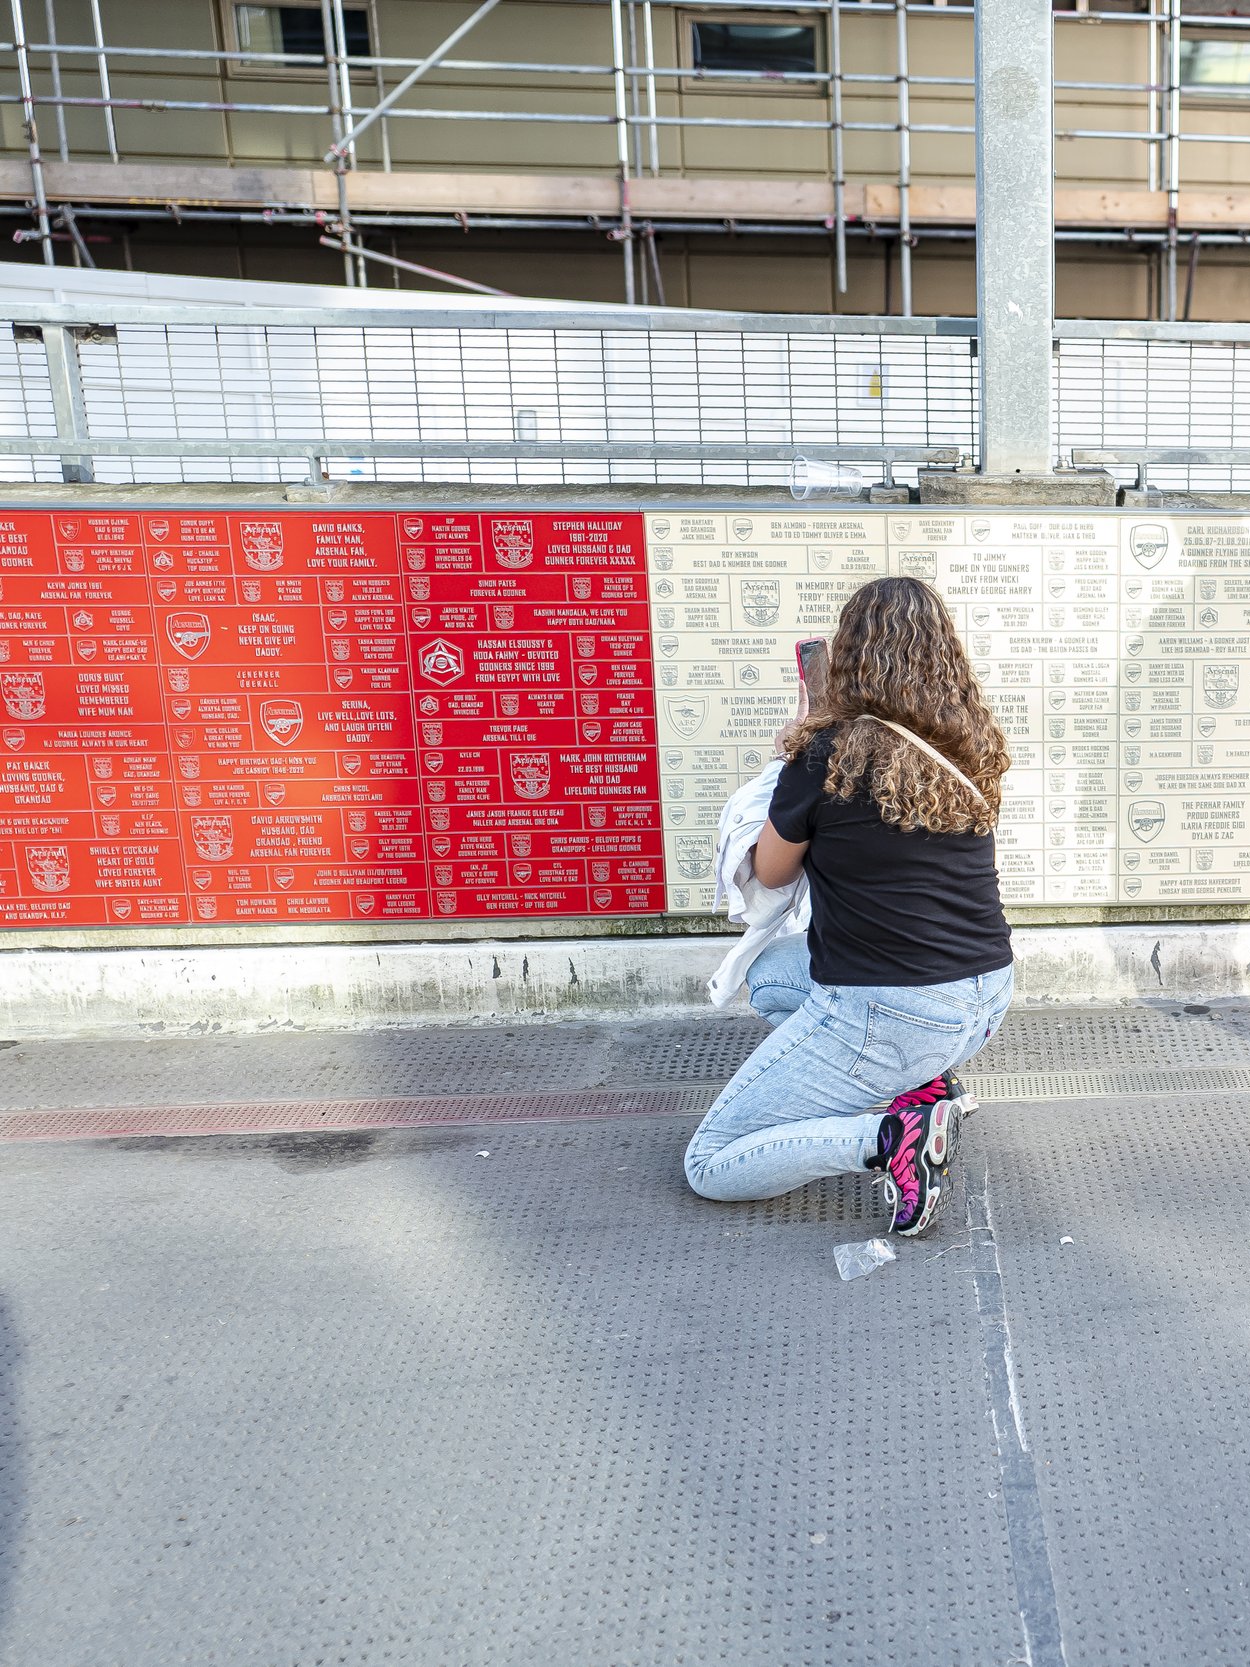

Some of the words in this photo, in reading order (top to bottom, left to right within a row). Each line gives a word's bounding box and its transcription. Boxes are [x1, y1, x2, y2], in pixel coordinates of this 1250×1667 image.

[553, 522, 585, 530] STEPHEN
[588, 522, 622, 530] HALLIDAY
[570, 533, 608, 542] 1961-2020
[548, 545, 570, 553] LOVED
[573, 545, 606, 553] HUSBAND
[616, 545, 631, 553] DAD
[545, 556, 574, 565] GUNNER
[576, 556, 607, 564] FOREVER
[974, 553, 981, 561] TO
[950, 564, 968, 572] COME
[971, 564, 980, 572] ON
[999, 564, 1029, 572] GUNNERS
[238, 625, 256, 633] KEEP
[260, 625, 269, 633] ON
[272, 625, 294, 633] GOING
[239, 636, 262, 645] NEVER
[264, 636, 281, 644] GIVE
[283, 636, 295, 644] UP!
[478, 640, 506, 648] HASSAN
[256, 648, 282, 656] DADDY.
[496, 651, 518, 659] FAHMY
[528, 651, 558, 659] DEVOTED
[479, 662, 512, 671] GOONERS
[515, 662, 535, 670] SINCE
[476, 674, 495, 682] FROM
[497, 674, 519, 682] EGYPT
[523, 673, 540, 681] WITH
[543, 673, 560, 682] LOVE
[721, 697, 728, 705] IN
[757, 696, 786, 704] MEMORY
[789, 696, 797, 704] OF
[731, 708, 751, 716] DAVID
[754, 707, 788, 715] MCGOWAN
[720, 730, 747, 738] ALWAYS
[750, 730, 757, 738] IN
[760, 729, 773, 738] OUR
[560, 754, 580, 762] MARK
[583, 754, 602, 762] JOHN
[604, 754, 646, 762] ROTHERHAM
[571, 765, 583, 773] THE
[585, 765, 602, 773] BEST
[605, 764, 638, 772] HUSBAND
[590, 776, 604, 784] AND
[606, 775, 620, 784] DAD
[564, 786, 597, 795] LIFELONG
[599, 786, 631, 794] GUNNERS
[634, 786, 646, 794] FAN
[1210, 811, 1239, 819] GUNNERS
[1232, 821, 1245, 829] GIGI
[1192, 832, 1212, 840] DYLAN
